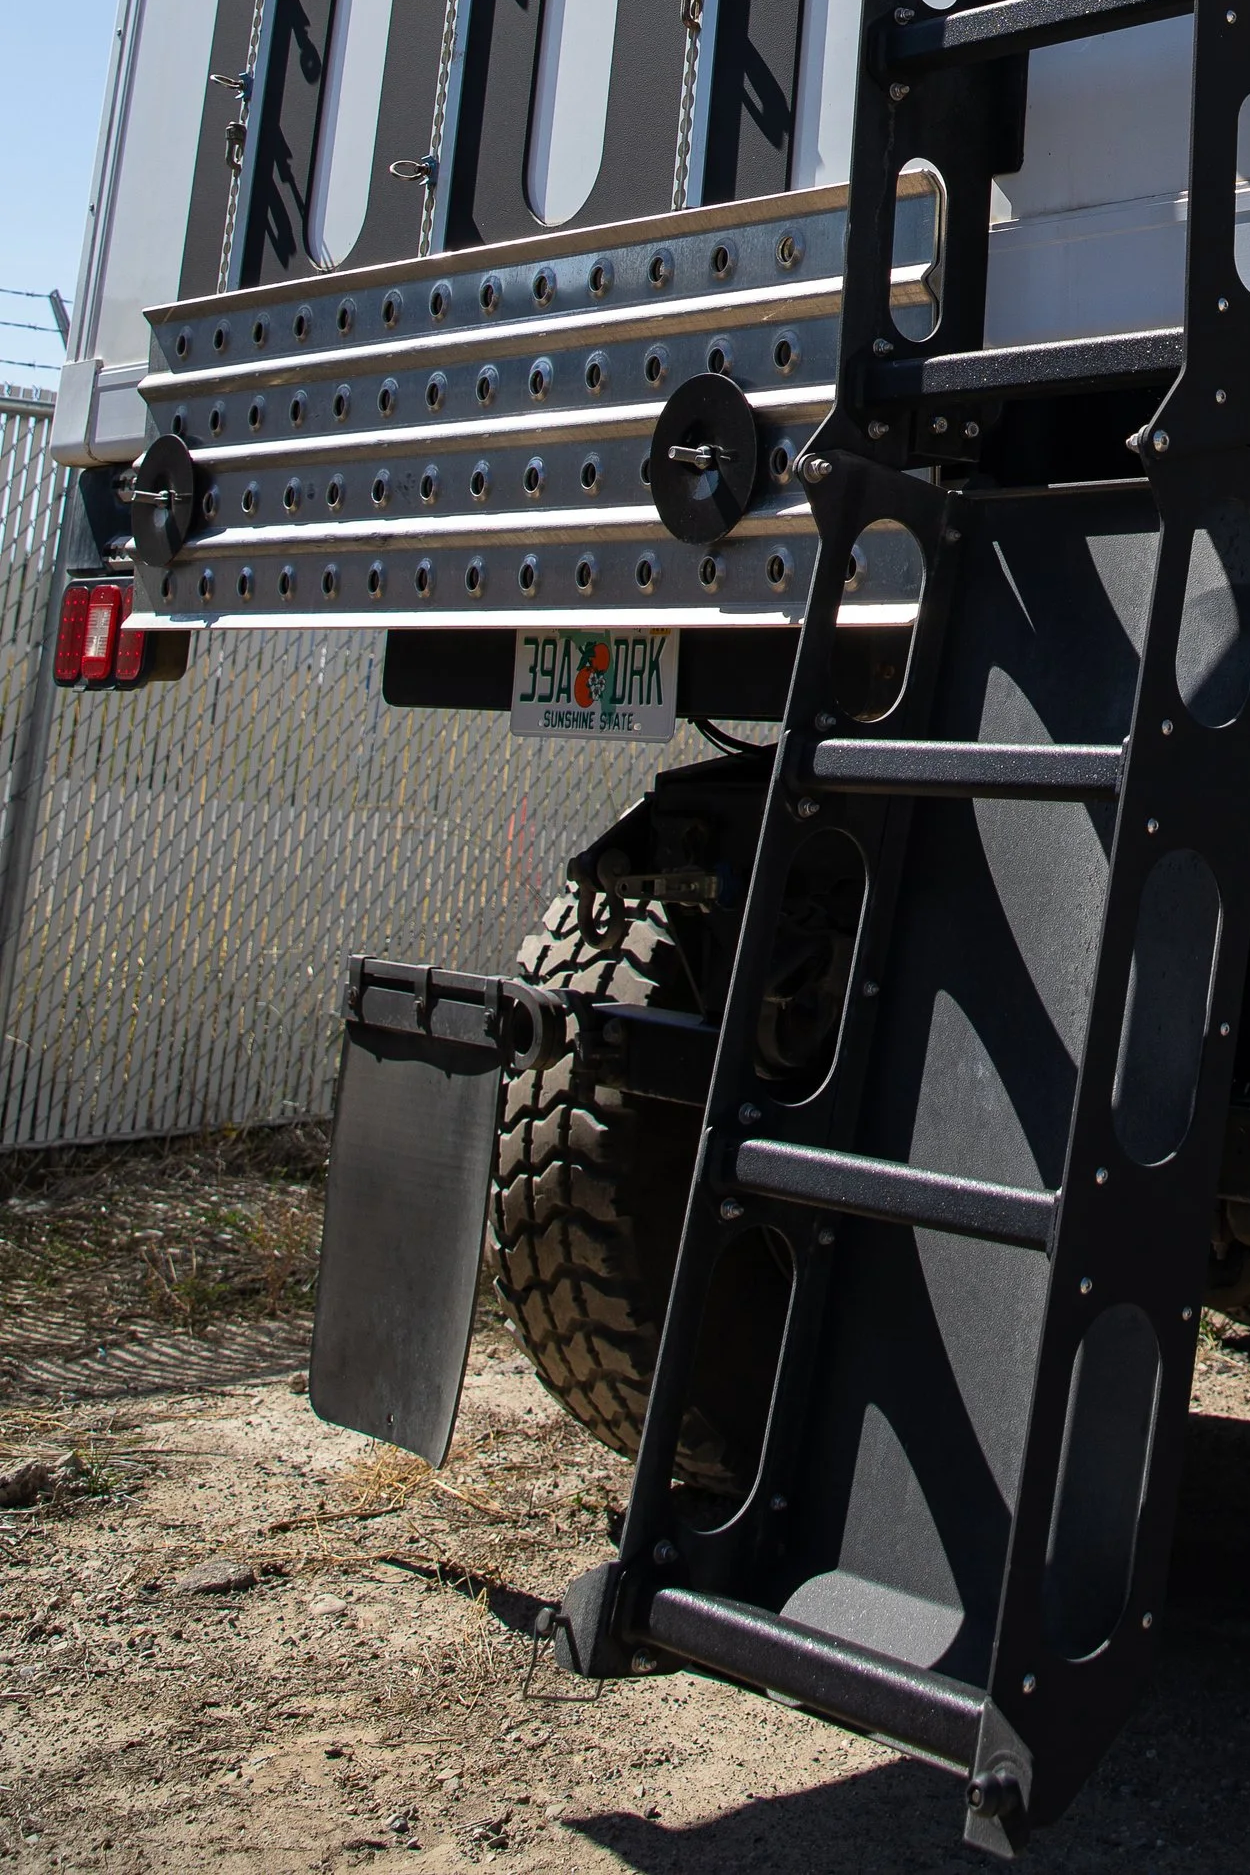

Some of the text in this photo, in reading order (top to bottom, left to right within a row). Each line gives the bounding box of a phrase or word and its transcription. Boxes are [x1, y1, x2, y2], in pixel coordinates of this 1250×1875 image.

[519, 636, 667, 706] 39A DRK
[543, 710, 634, 732] SUNSHINE STATE
